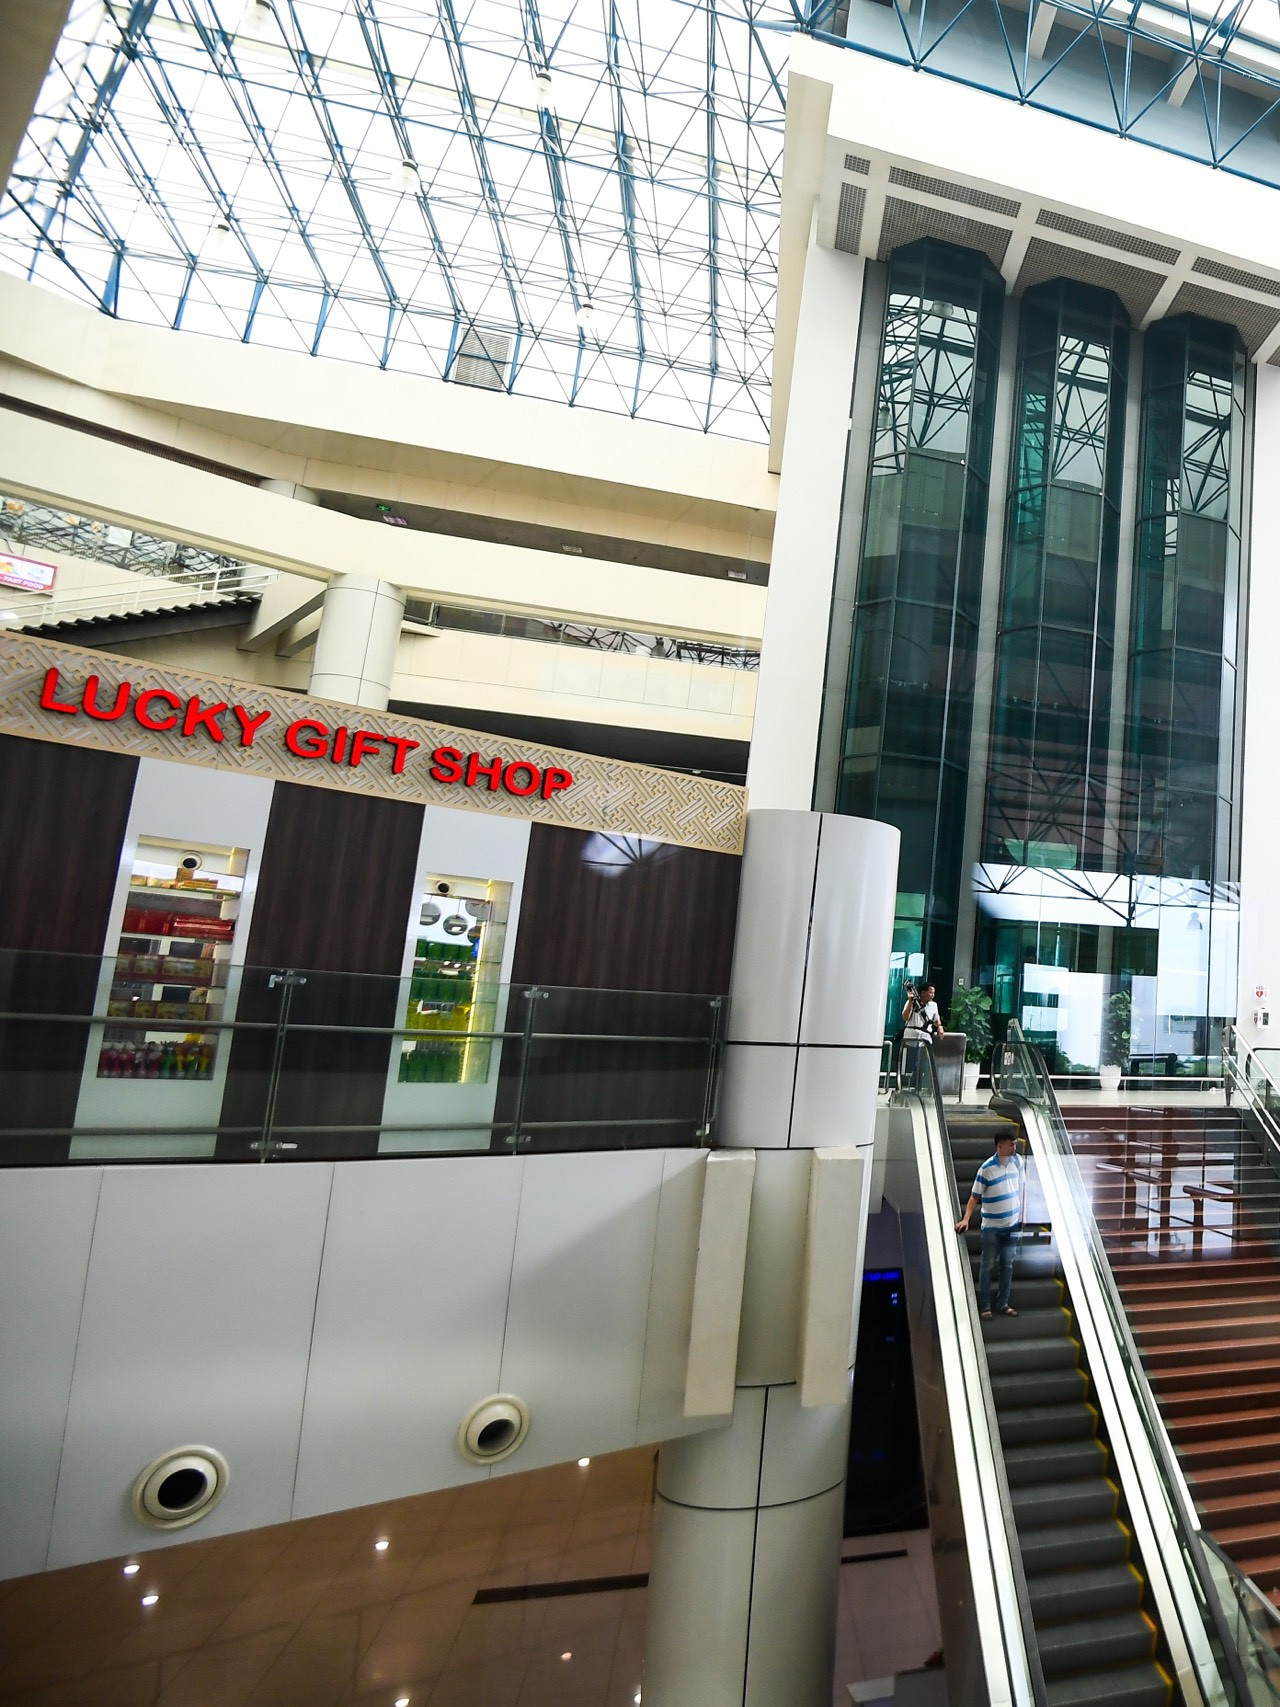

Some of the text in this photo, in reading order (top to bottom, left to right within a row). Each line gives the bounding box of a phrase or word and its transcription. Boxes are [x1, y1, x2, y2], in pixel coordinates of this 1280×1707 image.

[22, 579, 44, 590] FOOD
[40, 667, 574, 801] LUCKY GIFT SHOP
